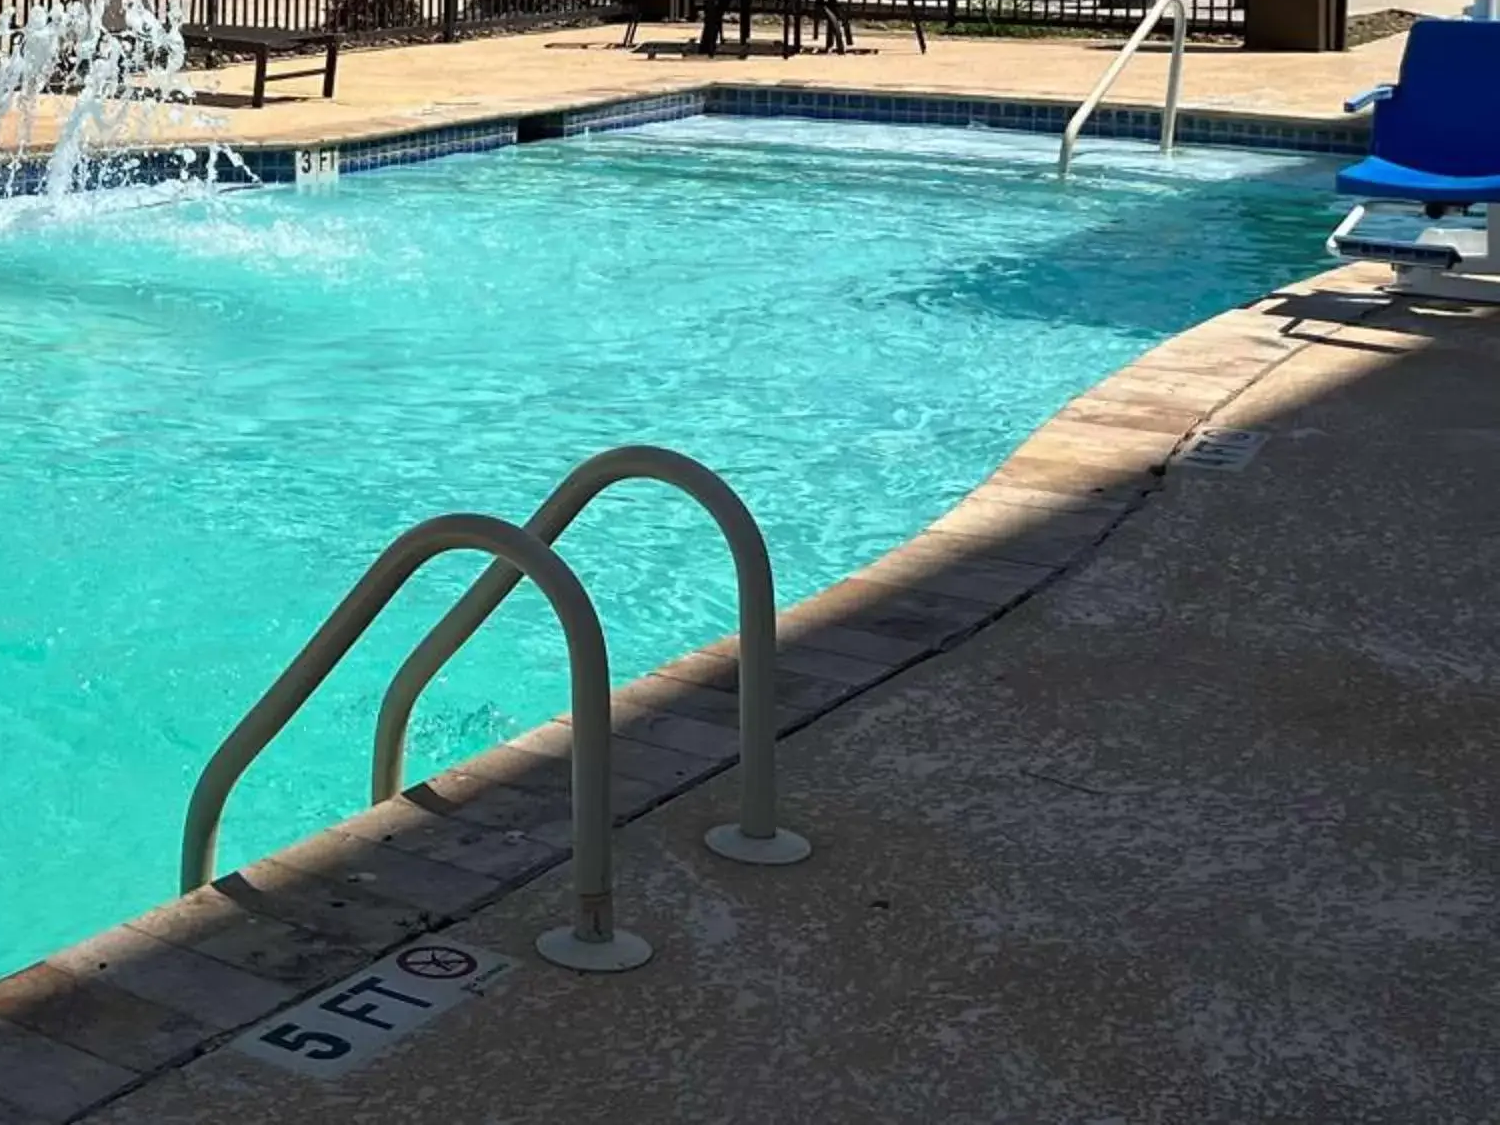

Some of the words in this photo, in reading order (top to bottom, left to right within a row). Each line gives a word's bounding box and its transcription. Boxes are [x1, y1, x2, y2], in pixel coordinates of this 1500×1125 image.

[301, 149, 311, 173] 3
[259, 1022, 352, 1060] 5
[318, 976, 432, 1030] FT
